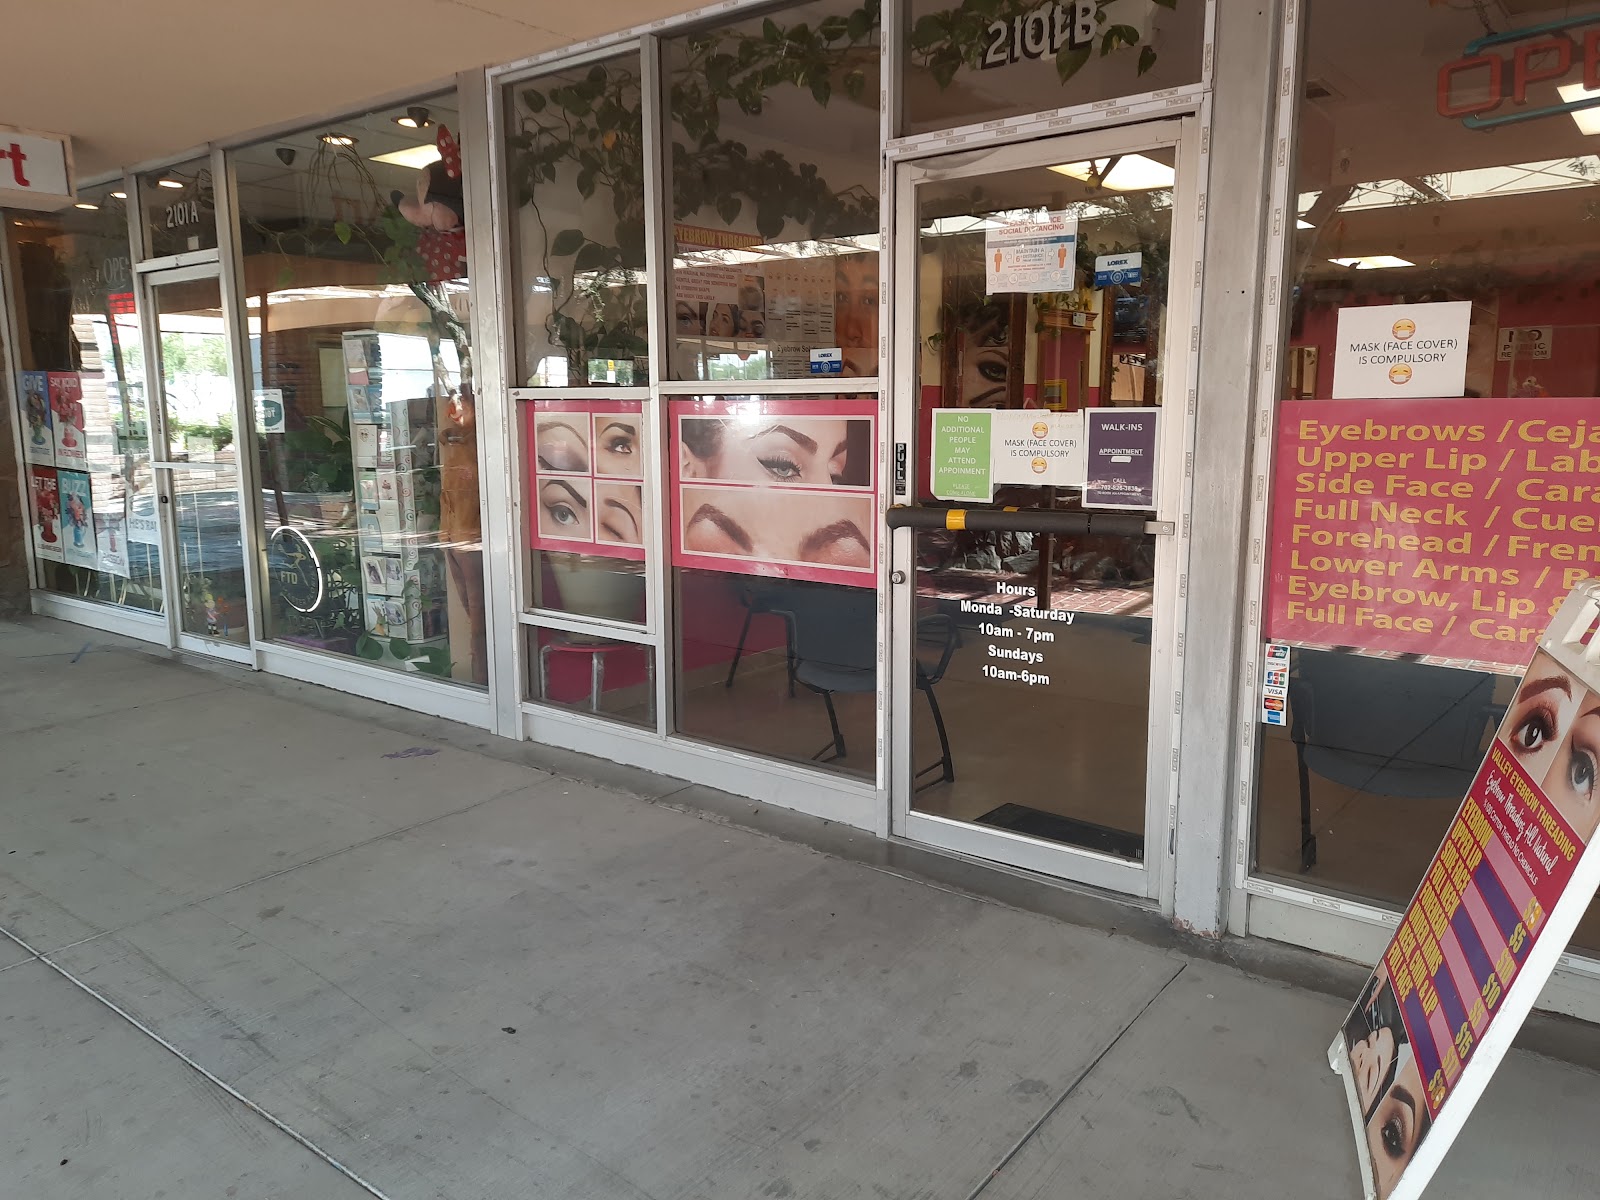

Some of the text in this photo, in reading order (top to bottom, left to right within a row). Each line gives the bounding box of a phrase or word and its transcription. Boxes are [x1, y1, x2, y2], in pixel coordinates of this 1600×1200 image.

[1350, 339, 1458, 352] MASK (FACE COVER)
[1359, 353, 1446, 364] IS COMPULSORY
[1026, 439, 1047, 448] (FACE
[1049, 440, 1077, 448] COVER)
[1299, 419, 1485, 446] Eyebrows
[897, 443, 905, 480] PULL
[938, 467, 986, 475] APPOINMENT
[1297, 447, 1414, 473] Upper
[1425, 448, 1487, 475] Lip
[1295, 473, 1375, 495] Side
[1386, 475, 1474, 499] Face
[1294, 499, 1358, 521] Full
[1371, 501, 1468, 526] Neck
[1512, 507, 1600, 533] Cue
[1292, 524, 1472, 554] Forehead
[1291, 550, 1402, 577] Lower
[1412, 559, 1520, 586] Arms
[996, 582, 1036, 596] Hours
[1288, 576, 1459, 612] Eyebrow,
[1472, 590, 1535, 619] Lip
[960, 600, 1002, 615] Monda
[1287, 601, 1345, 625] Full
[1355, 608, 1433, 634] Face
[979, 622, 1013, 637] 10am
[1026, 627, 1054, 643] 7pm
[988, 644, 1043, 664] Sundays
[982, 665, 1050, 685] 10am-6pm
[1490, 746, 1576, 862] VALLEY EYEBROW THREADING
[1461, 796, 1493, 850] EYEBROW
[1482, 768, 1558, 875] Eyebrow Threading All Natural
[1451, 818, 1527, 956] UPPER LIP $5
[1419, 879, 1448, 942] FOREHEAD
[1440, 838, 1516, 986] SIDE FACE $10
[1429, 859, 1502, 1012] FULL NECK $10
[1387, 940, 1403, 977] FULL
[1395, 962, 1412, 1004] FACE
[1408, 948, 1426, 990] CHIN
[1408, 899, 1475, 1061] UNDER ARMS $15
[1418, 977, 1429, 1001] &
[1422, 985, 1438, 1020] LIP
